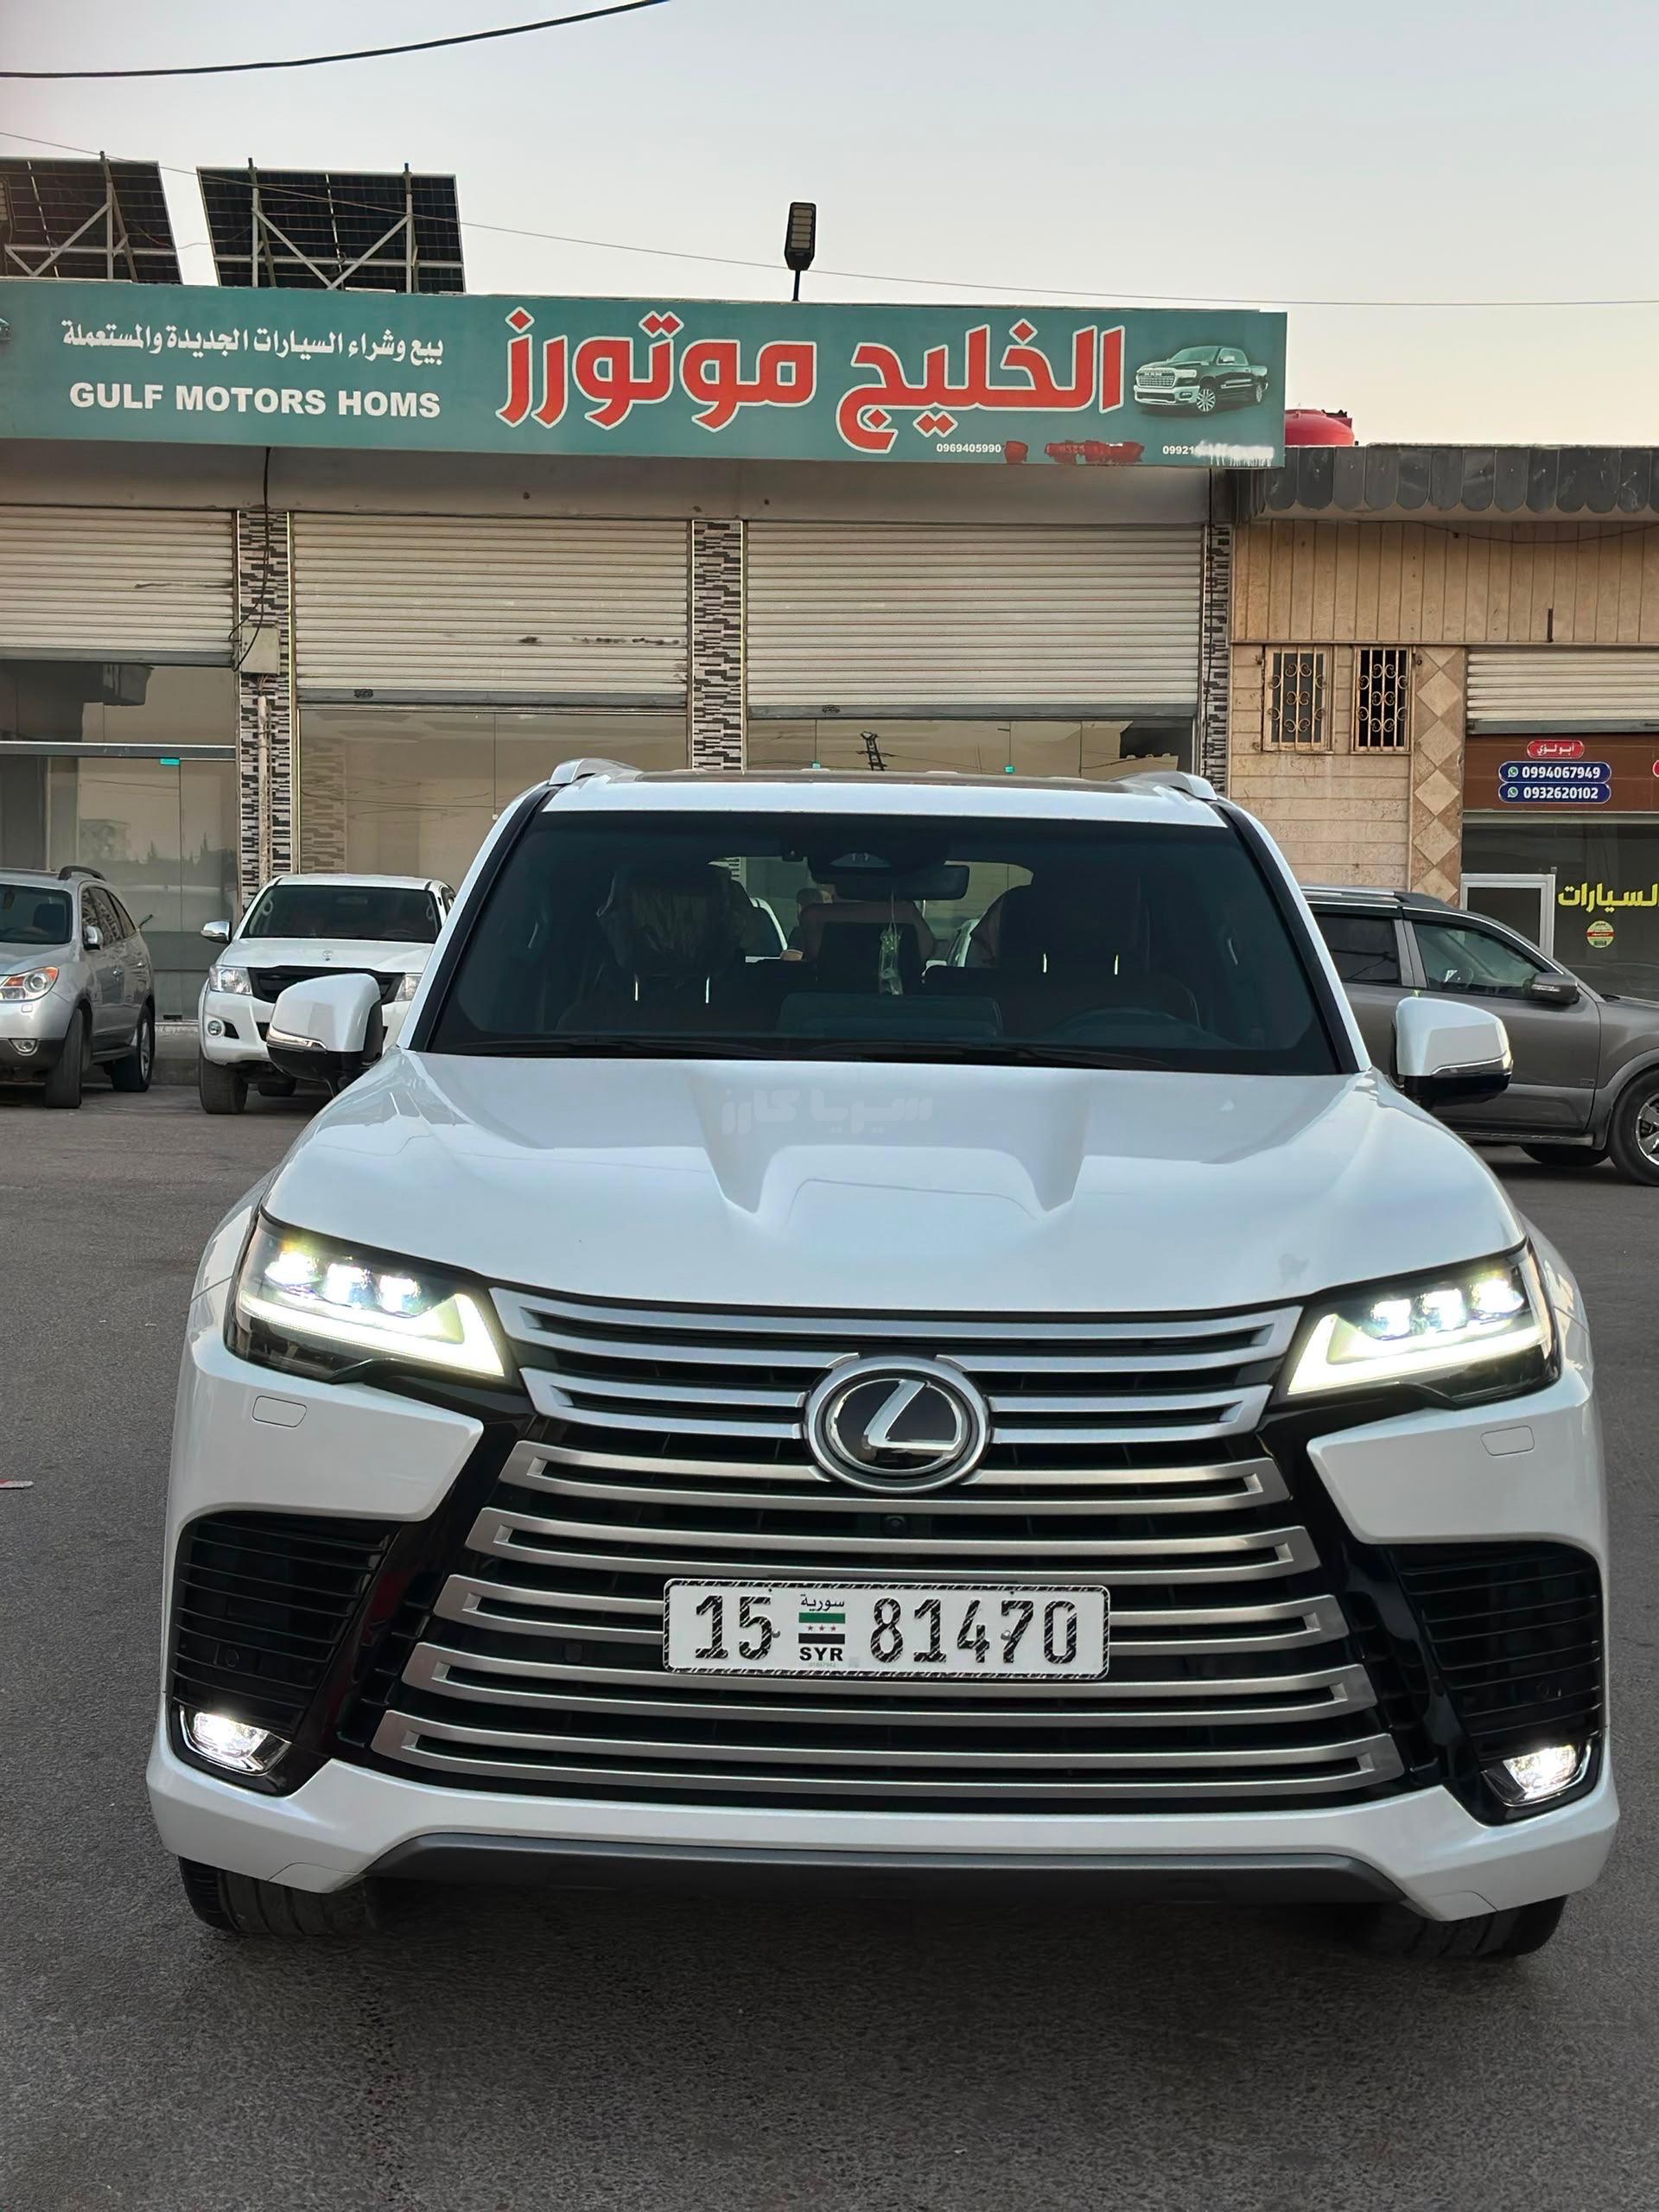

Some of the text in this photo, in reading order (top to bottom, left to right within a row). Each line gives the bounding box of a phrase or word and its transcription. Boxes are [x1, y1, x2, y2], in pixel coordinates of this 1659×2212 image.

[60, 320, 443, 365] بيع وشراء السيارات الجديدة والمستعملة
[495, 307, 1126, 454] الخليج موتورز
[69, 382, 441, 418] GULF MOTORS HOMS
[936, 442, 1002, 454] 0969405990
[1559, 743, 1575, 755] أبو
[1522, 766, 1601, 779] 0994067949
[1523, 787, 1599, 799] 0932620102
[1558, 882, 1659, 913] لسيارات
[800, 1593, 845, 1612] سورية
[695, 1595, 1078, 1665] 15 81470
[798, 1646, 844, 1662] SYR
